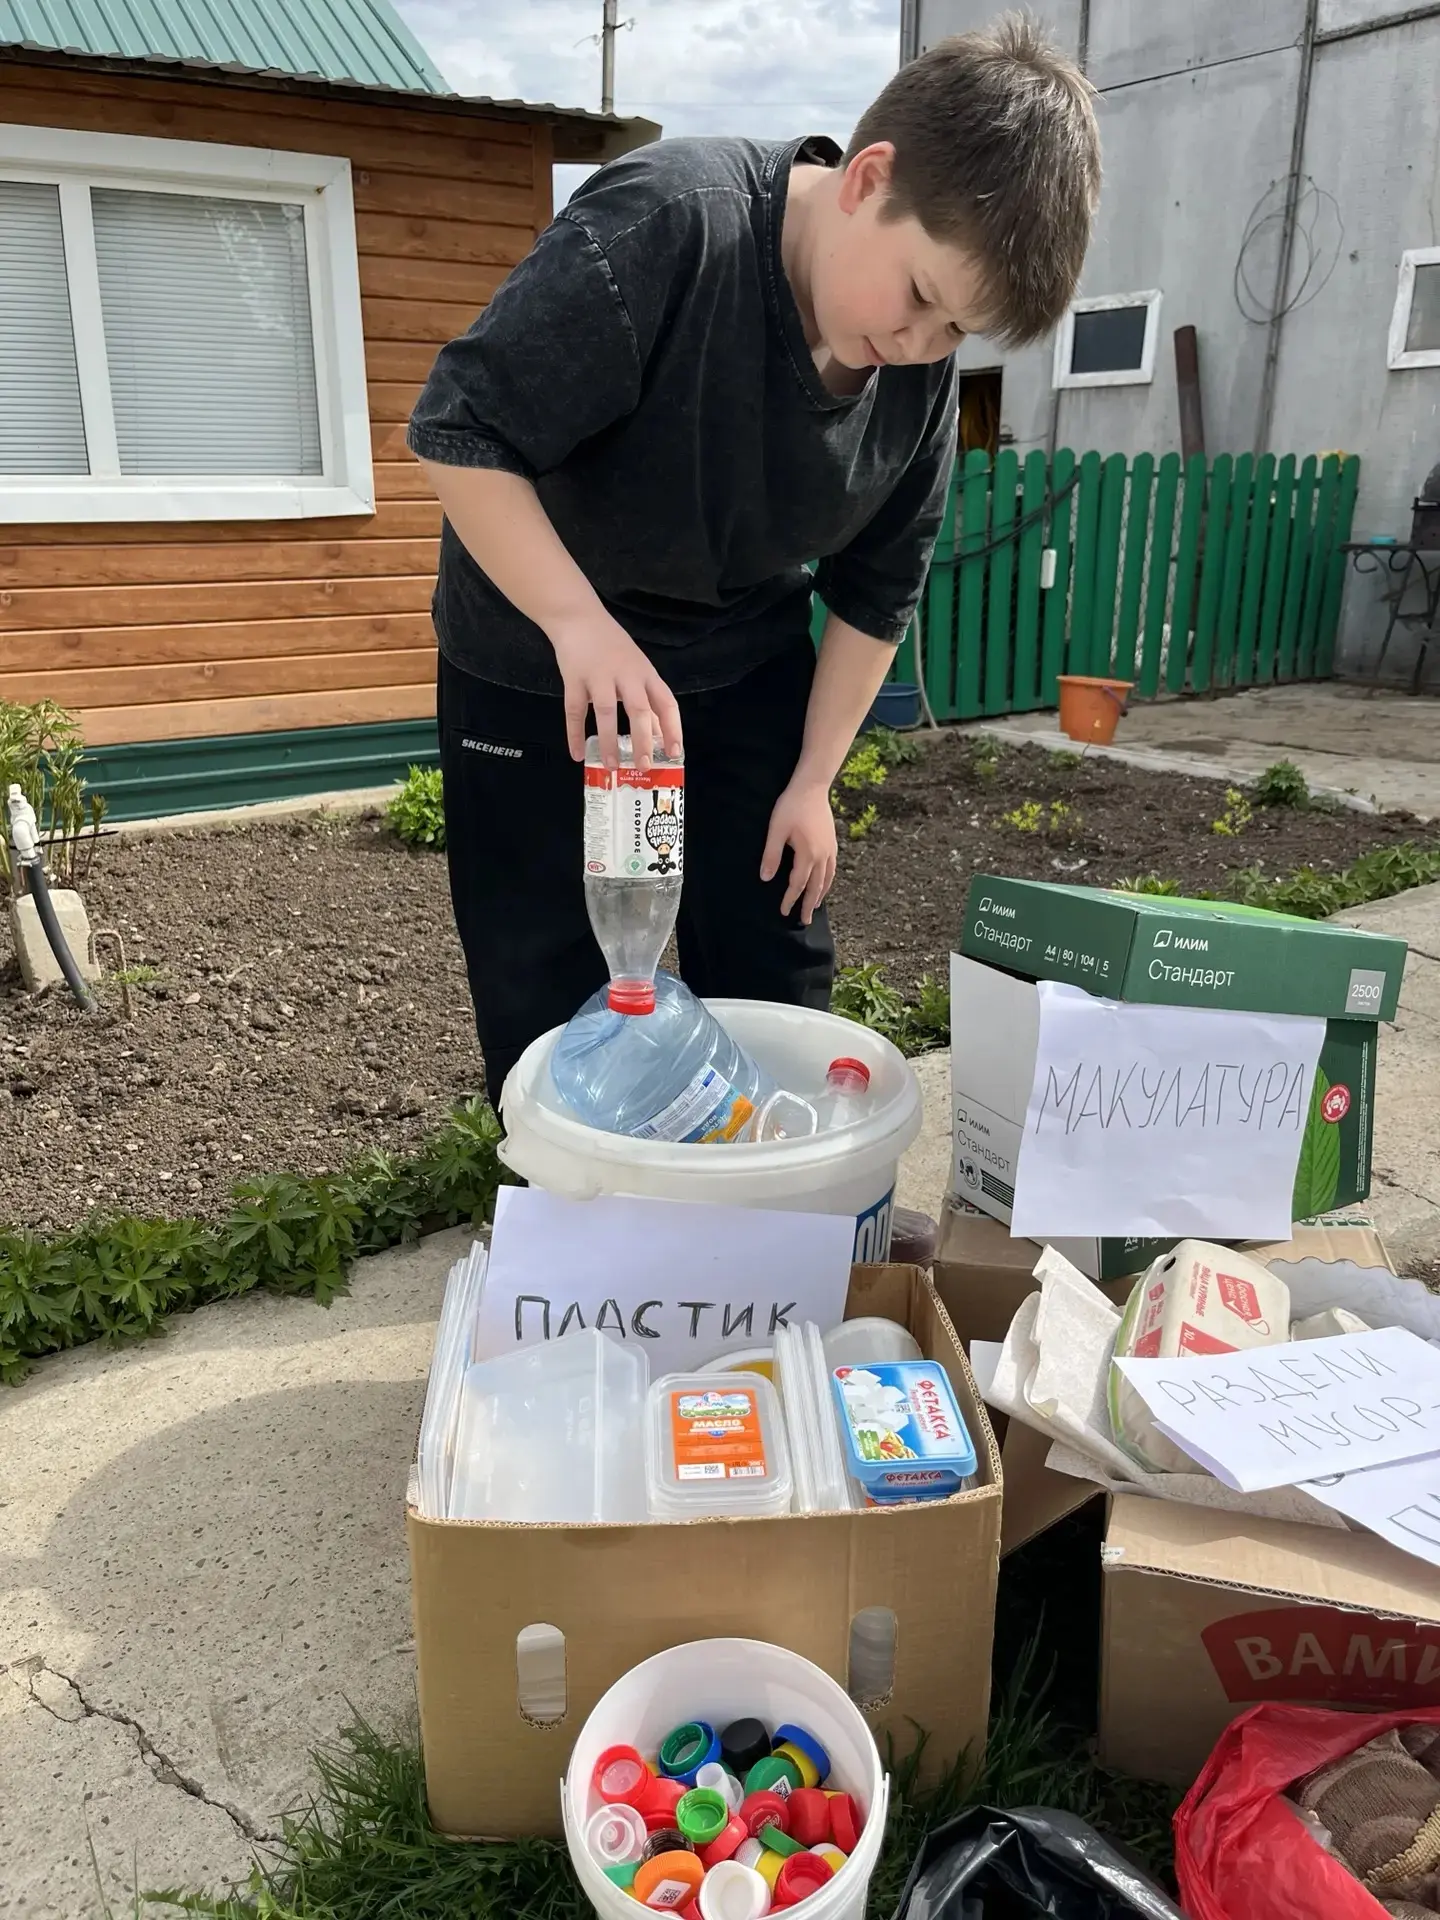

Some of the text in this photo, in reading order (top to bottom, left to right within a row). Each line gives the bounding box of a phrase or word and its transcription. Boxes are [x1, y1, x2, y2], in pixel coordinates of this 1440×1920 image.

[634, 799, 642, 854] ОТБОРНОЕ
[647, 825, 678, 837] ВАЖНАЯ
[649, 815, 677, 828] КОРОВА
[652, 835, 676, 846] ОЧЕНЬ
[973, 919, 1033, 952] Стандарт
[1062, 949, 1074, 961] 80
[1080, 954, 1095, 967] 104
[1103, 960, 1110, 972] 5
[1148, 958, 1235, 988] Стандарт
[1351, 984, 1380, 999] 2500
[1036, 1061, 1305, 1135] МАКУЛАТУРА
[957, 1129, 1011, 1173] Стандарт
[514, 1294, 798, 1341] ПЛАСТИК
[1156, 1347, 1397, 1416] РАЗДЕЛИ
[692, 1418, 743, 1429] МАСЛО
[918, 1380, 951, 1440] ФЕТАКСА
[885, 1471, 943, 1482] ФЕТАКСА
